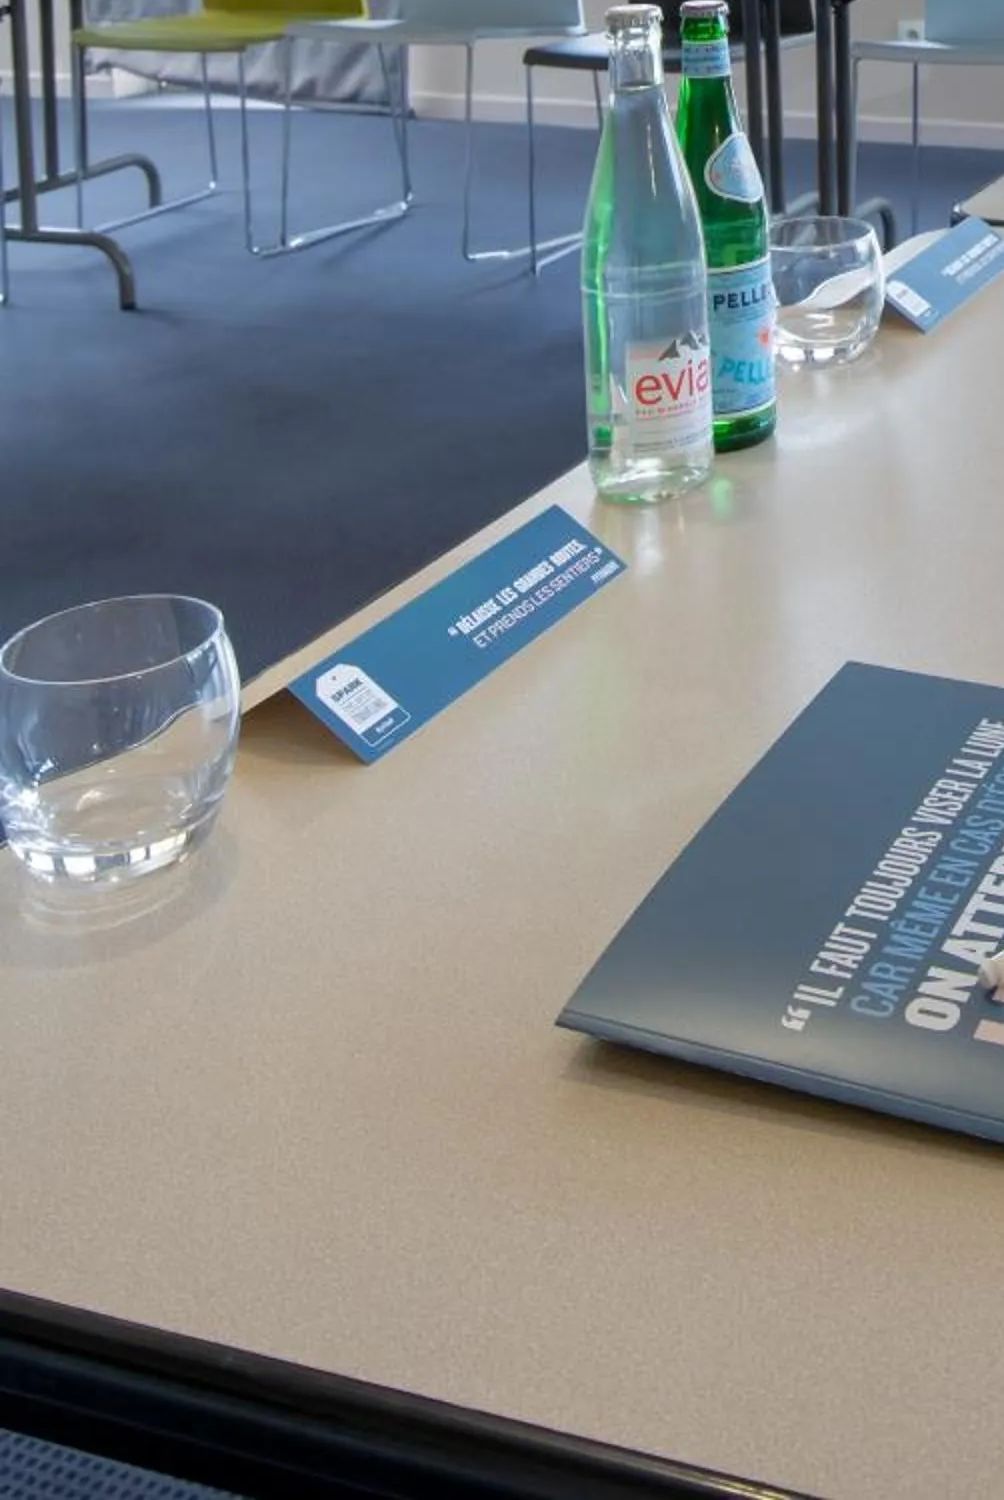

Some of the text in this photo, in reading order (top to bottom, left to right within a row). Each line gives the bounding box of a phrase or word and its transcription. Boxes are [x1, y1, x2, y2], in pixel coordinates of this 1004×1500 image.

[472, 630, 492, 648] ET
[488, 599, 535, 638] PRENDS
[530, 585, 554, 606] LES
[810, 922, 878, 979] FAUT
[845, 826, 943, 921] TOUJOURS
[911, 777, 977, 825] VISER
[946, 757, 992, 779] LA
[850, 961, 916, 1019] CAR
[883, 887, 960, 960] MÊME
[928, 856, 979, 886] EN
[904, 965, 980, 1031] ON
